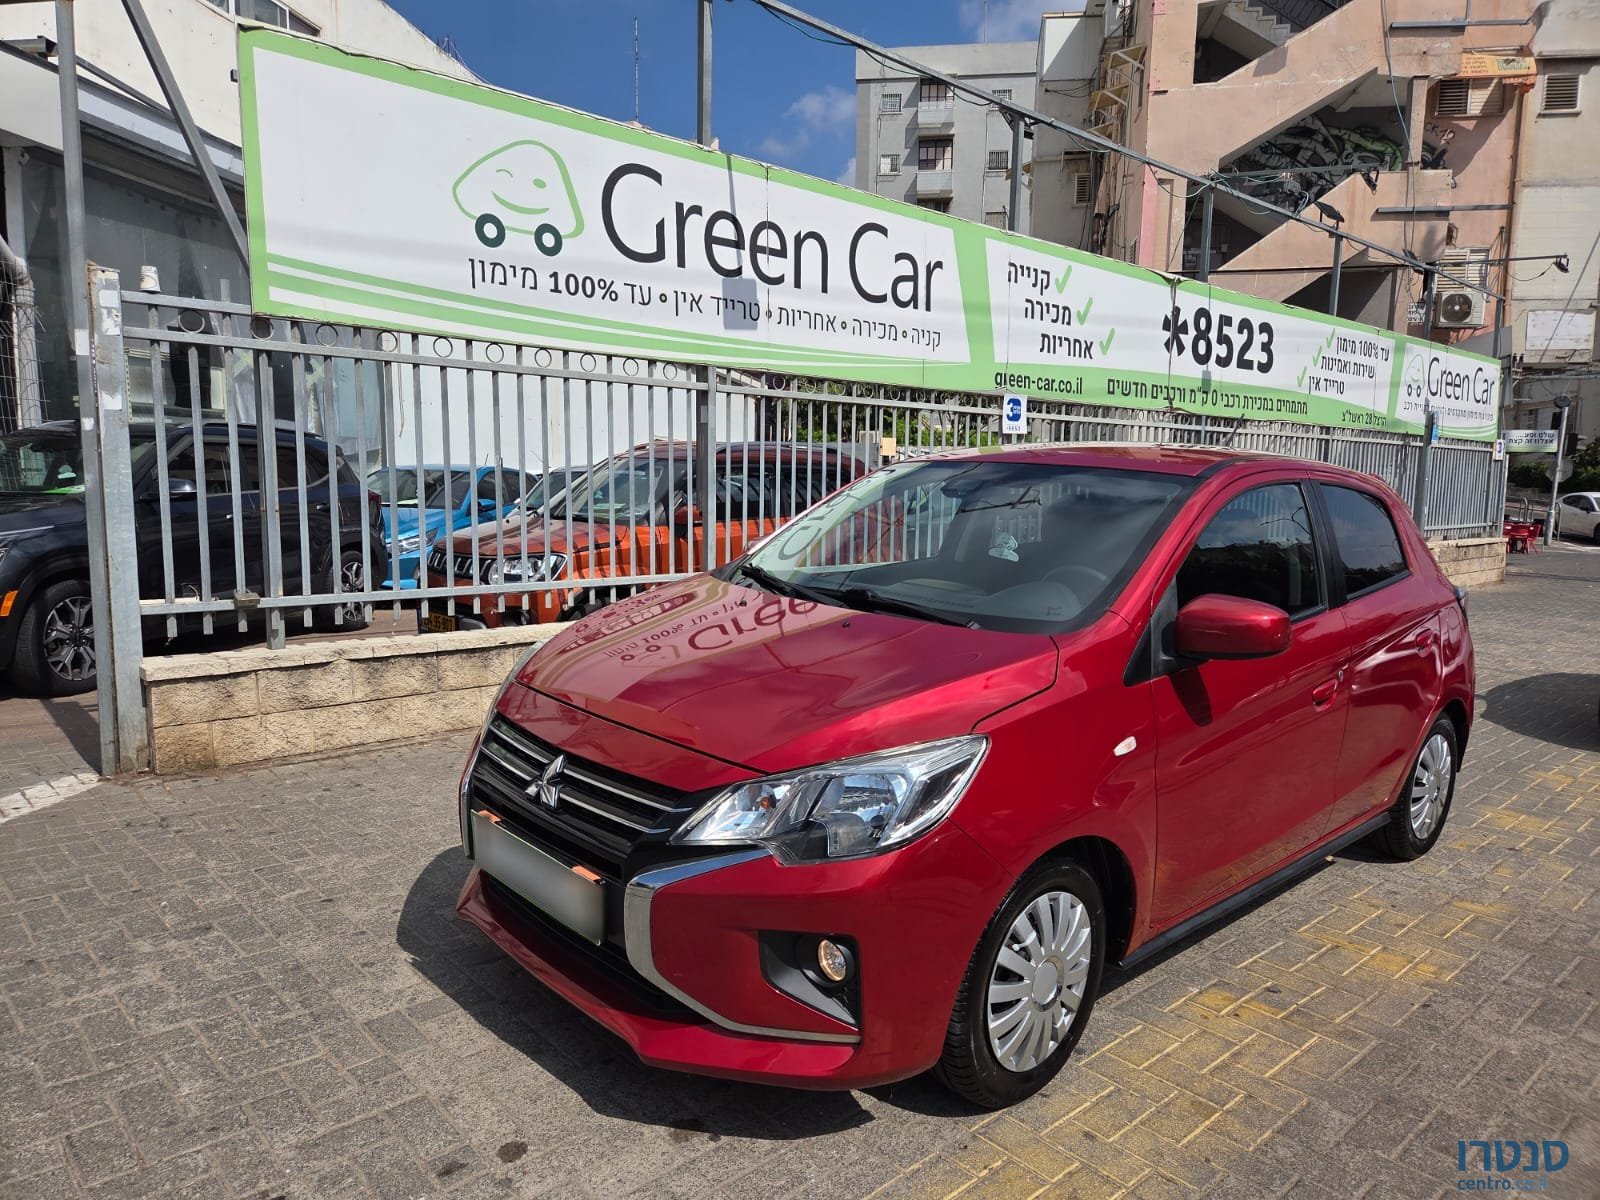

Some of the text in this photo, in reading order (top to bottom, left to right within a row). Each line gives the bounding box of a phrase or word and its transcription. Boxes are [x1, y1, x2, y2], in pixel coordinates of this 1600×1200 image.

[601, 163, 943, 311] Green Car
[1007, 261, 1050, 296] קנייה
[468, 258, 941, 352] קניה מכירה אחריות טרייד אין עד 100% מימון
[1025, 298, 1071, 326] מכירה
[1040, 333, 1093, 359] אחריות
[1336, 336, 1390, 361] עד 100% מימון
[1321, 355, 1375, 379] שירות ואמינות
[1107, 378, 1147, 398] חדשים
[1308, 375, 1344, 394] טרייד אין
[1428, 356, 1495, 405] Green Car
[1152, 384, 1185, 403] ורכבים
[1211, 389, 1217, 406] 0
[1220, 392, 1240, 408] רכבי
[1243, 395, 1273, 411] במכירת
[1277, 399, 1308, 415] מתמחים
